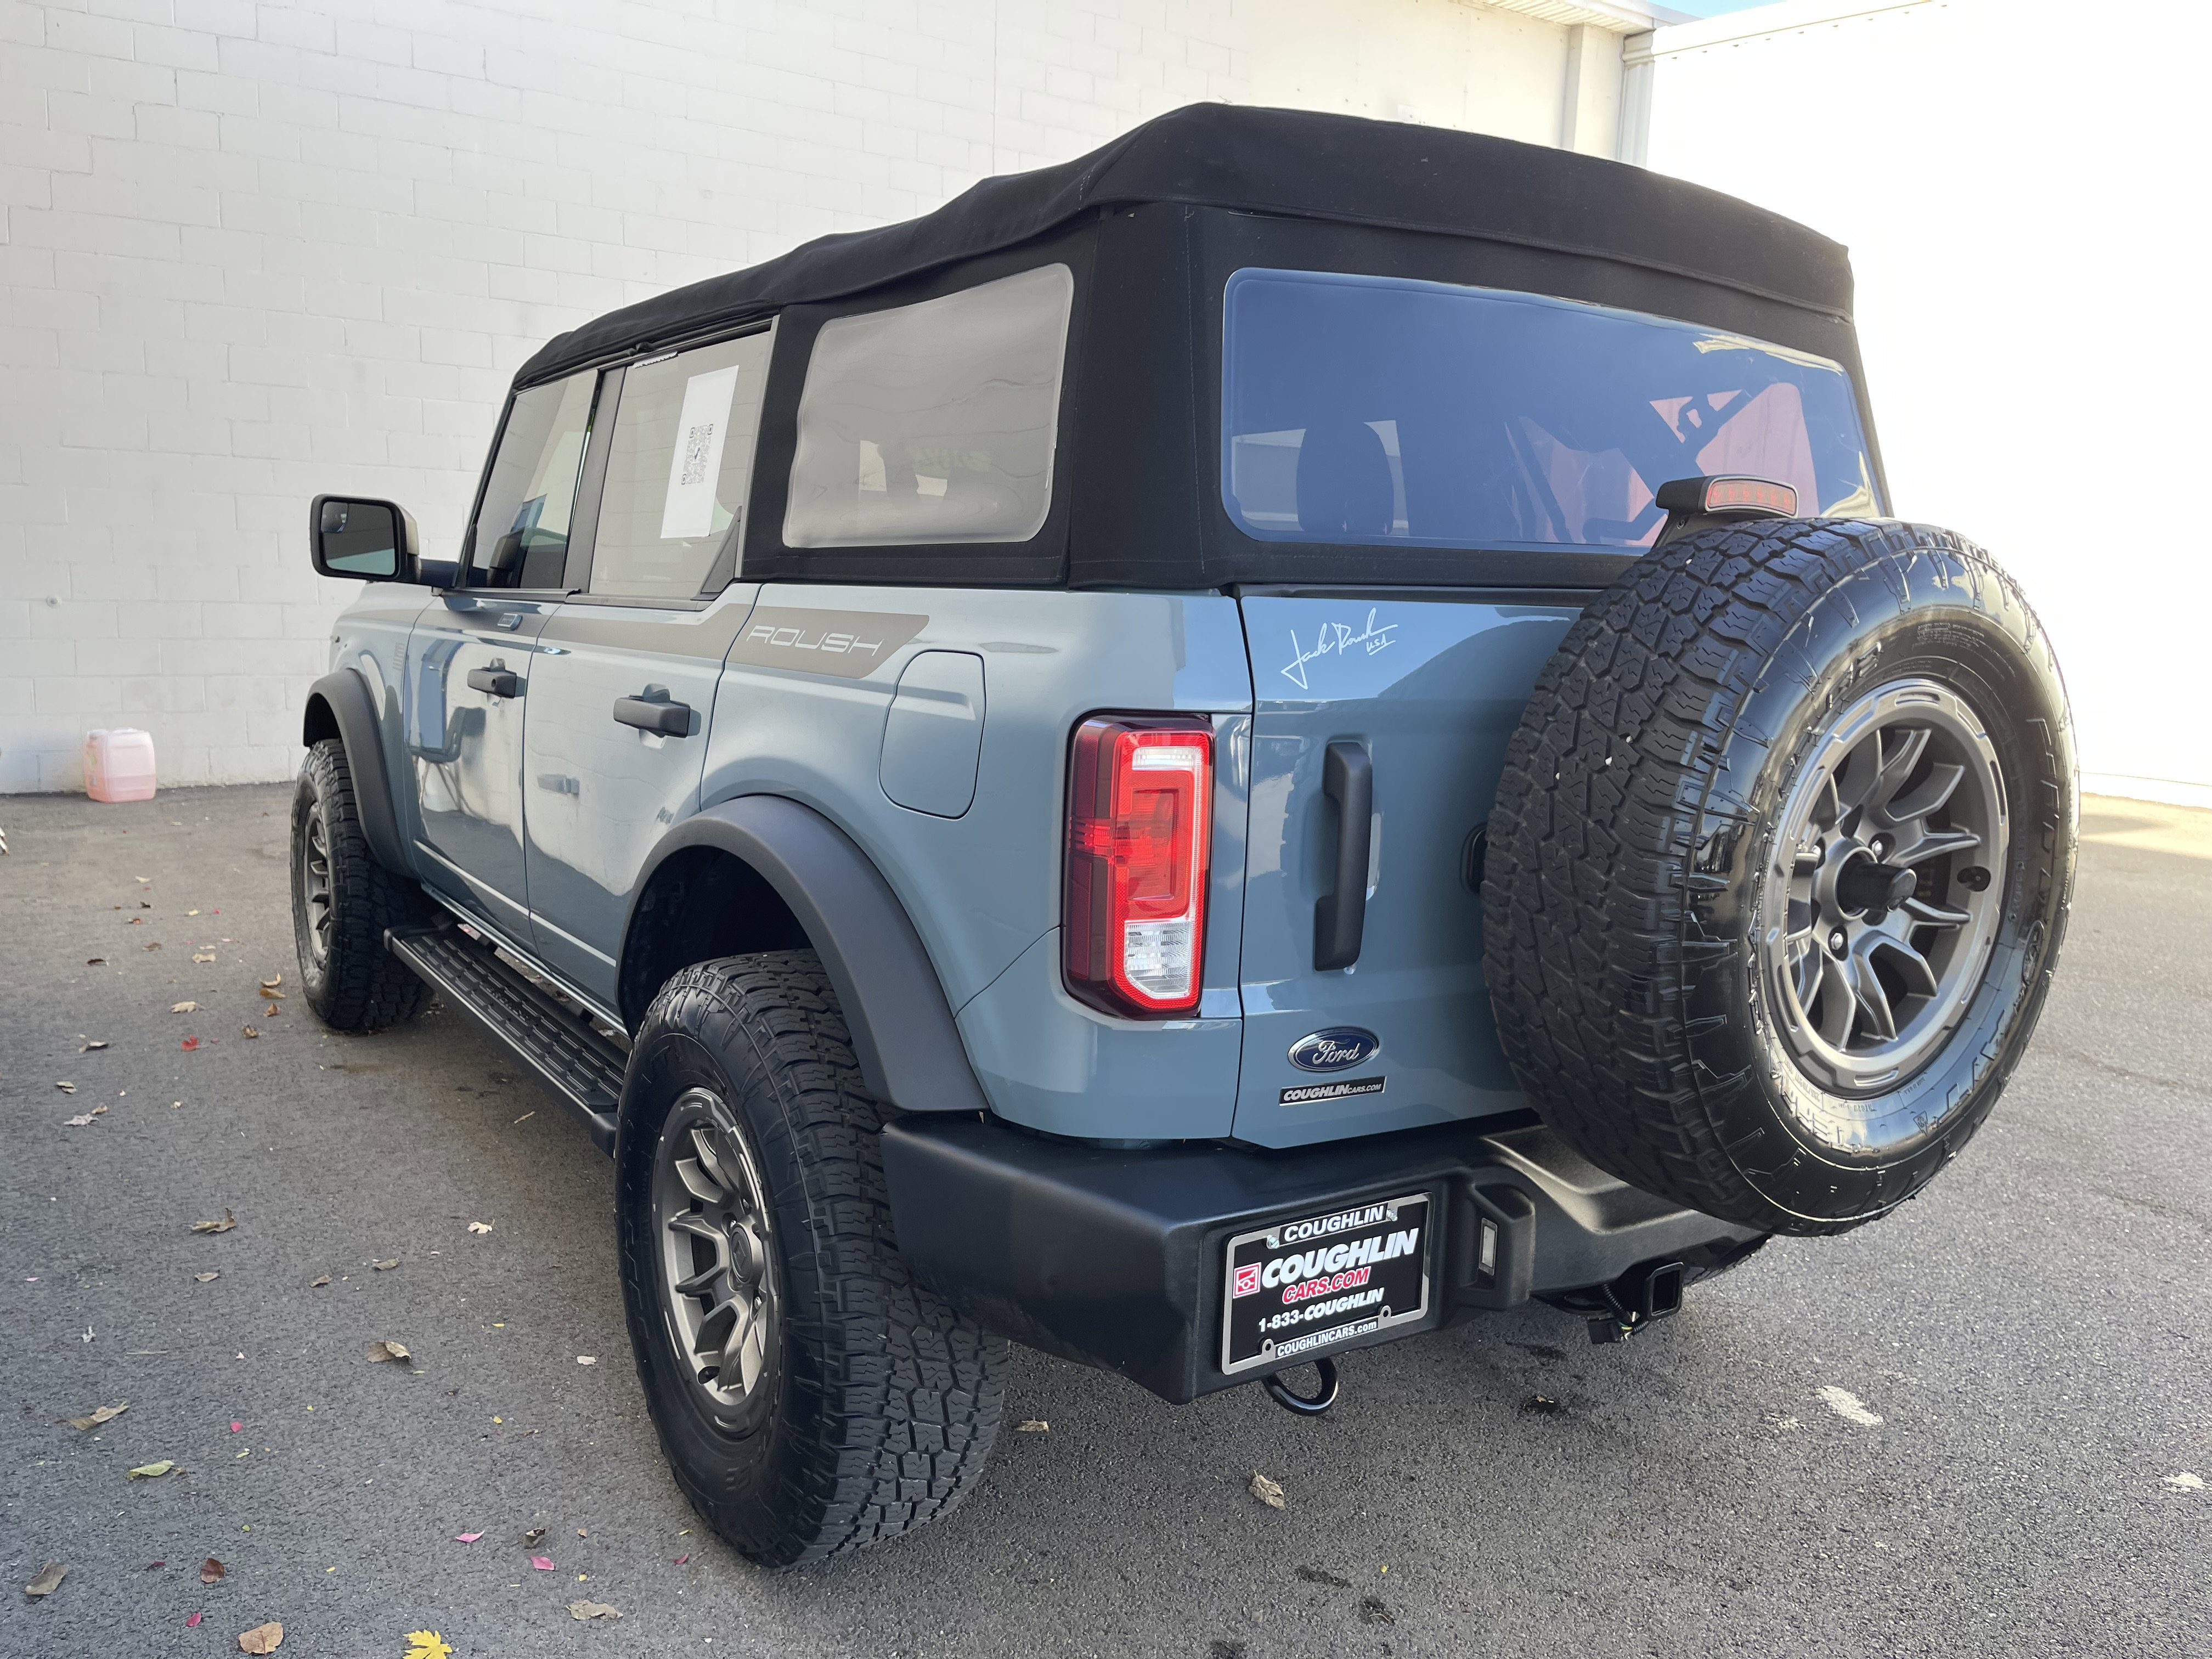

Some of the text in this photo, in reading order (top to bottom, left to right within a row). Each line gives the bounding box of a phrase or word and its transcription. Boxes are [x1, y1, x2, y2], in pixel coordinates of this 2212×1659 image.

[746, 625, 885, 657] ROUSH
[1366, 633, 1392, 653] USA
[1312, 1039, 1361, 1065] Ford
[1283, 1083, 1382, 1101] COUGHLINCARS.COM
[1284, 1205, 1384, 1242] COUGHLIN
[1262, 1227, 1419, 1289] COUGHLIN
[1282, 1266, 1371, 1305] CARS.COM
[1259, 1287, 1385, 1332] 1-833-COUGHLIN
[1277, 1320, 1378, 1357] COUGHLINCARS.com
